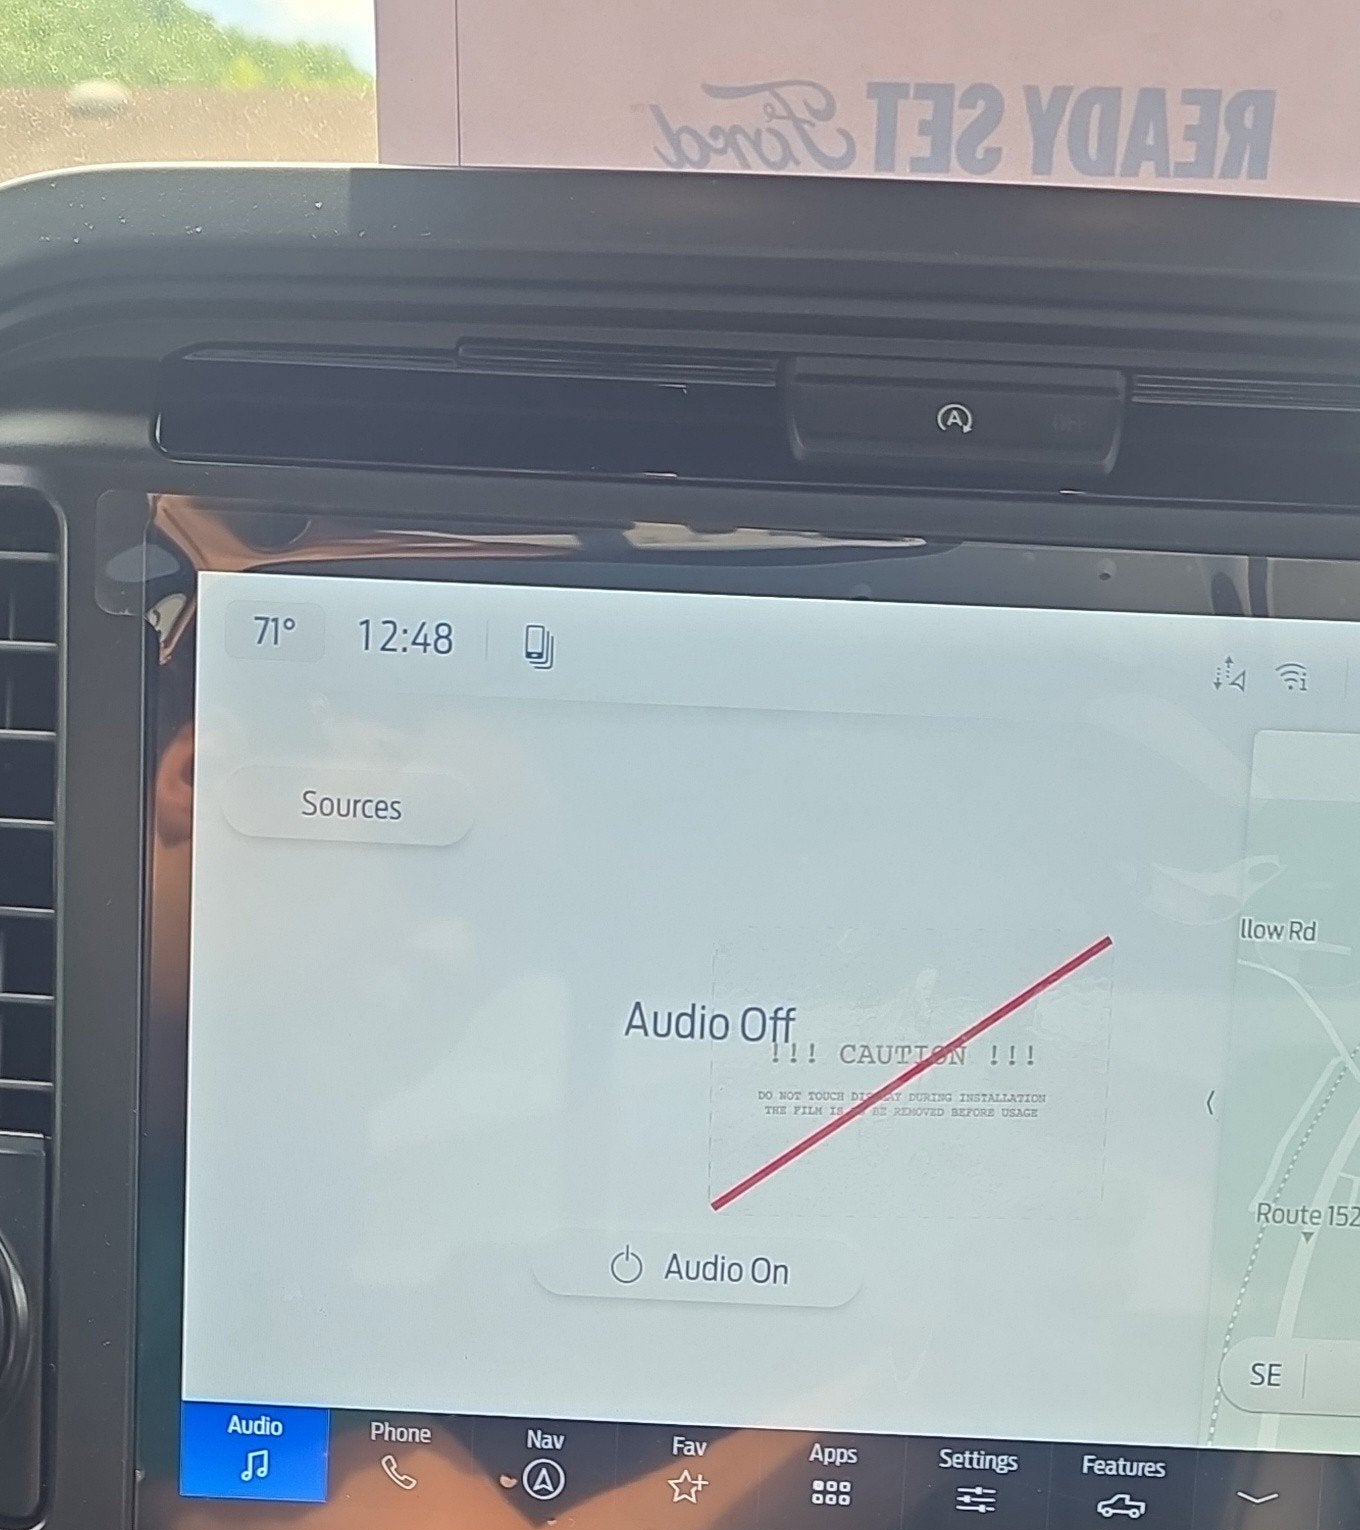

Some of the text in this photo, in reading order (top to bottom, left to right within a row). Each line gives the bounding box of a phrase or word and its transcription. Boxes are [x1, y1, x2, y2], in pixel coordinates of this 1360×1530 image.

[253, 616, 296, 646] 71°
[359, 618, 454, 655] 12:48
[301, 790, 402, 820] Sources
[1288, 920, 1318, 942] Rd
[624, 1001, 797, 1043] Audio Off
[839, 1043, 968, 1066] CAUTION
[991, 1044, 1035, 1067] !!!
[757, 1090, 773, 1101] DO
[780, 1091, 802, 1101] NOT
[808, 1091, 845, 1102] TOUCH
[908, 1092, 953, 1103] DURING
[959, 1093, 1047, 1104] INSTALLATION
[765, 1105, 787, 1116] THE
[793, 1106, 823, 1116] FILM
[893, 1107, 945, 1118] REMOVED
[950, 1107, 995, 1118] BEFORE
[1001, 1108, 1039, 1119] USAGE
[1256, 1203, 1322, 1227] Route
[664, 1253, 789, 1285] Audio On
[1250, 1362, 1283, 1387] SE
[227, 1414, 284, 1437] Audio
[370, 1421, 432, 1445] Phone
[526, 1428, 565, 1450] Nav
[672, 1435, 708, 1457] Fav
[809, 1442, 858, 1467] Apps
[939, 1447, 1019, 1475] Settings
[1082, 1454, 1167, 1479] Features
